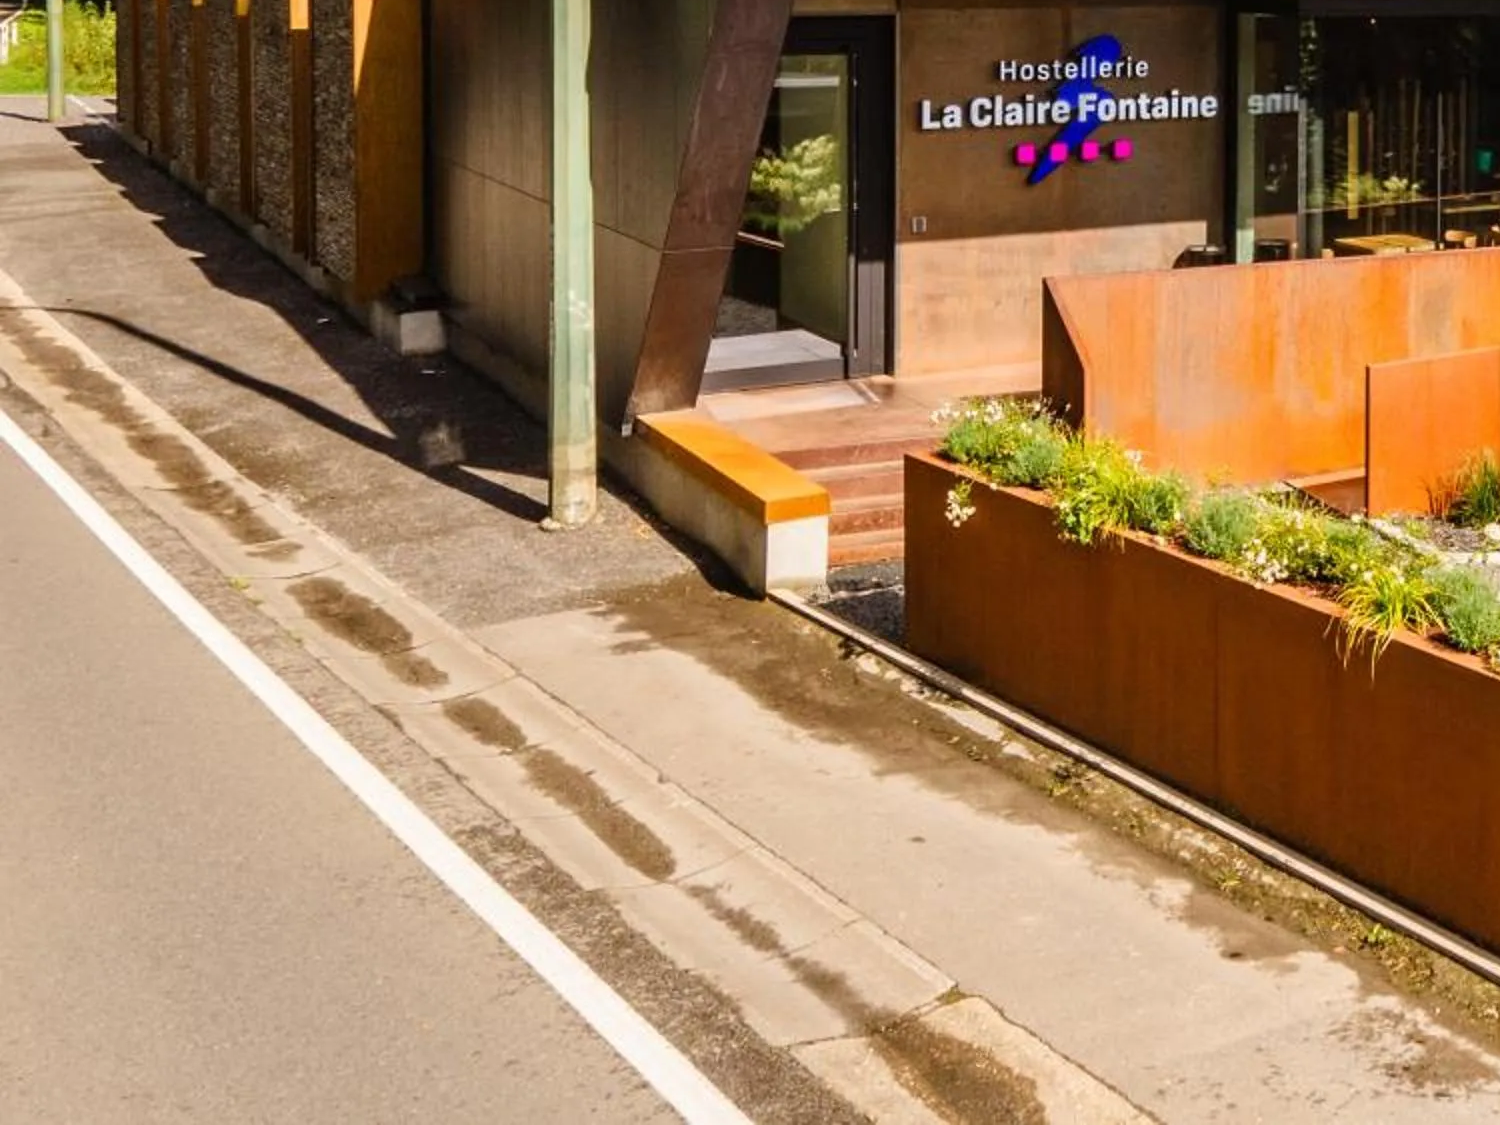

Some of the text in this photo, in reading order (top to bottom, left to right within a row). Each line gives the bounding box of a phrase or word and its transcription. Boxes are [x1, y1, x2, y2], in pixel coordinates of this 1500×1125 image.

[1000, 55, 1149, 81] Hostellerie
[921, 88, 1218, 130] La Claire Fontaine
